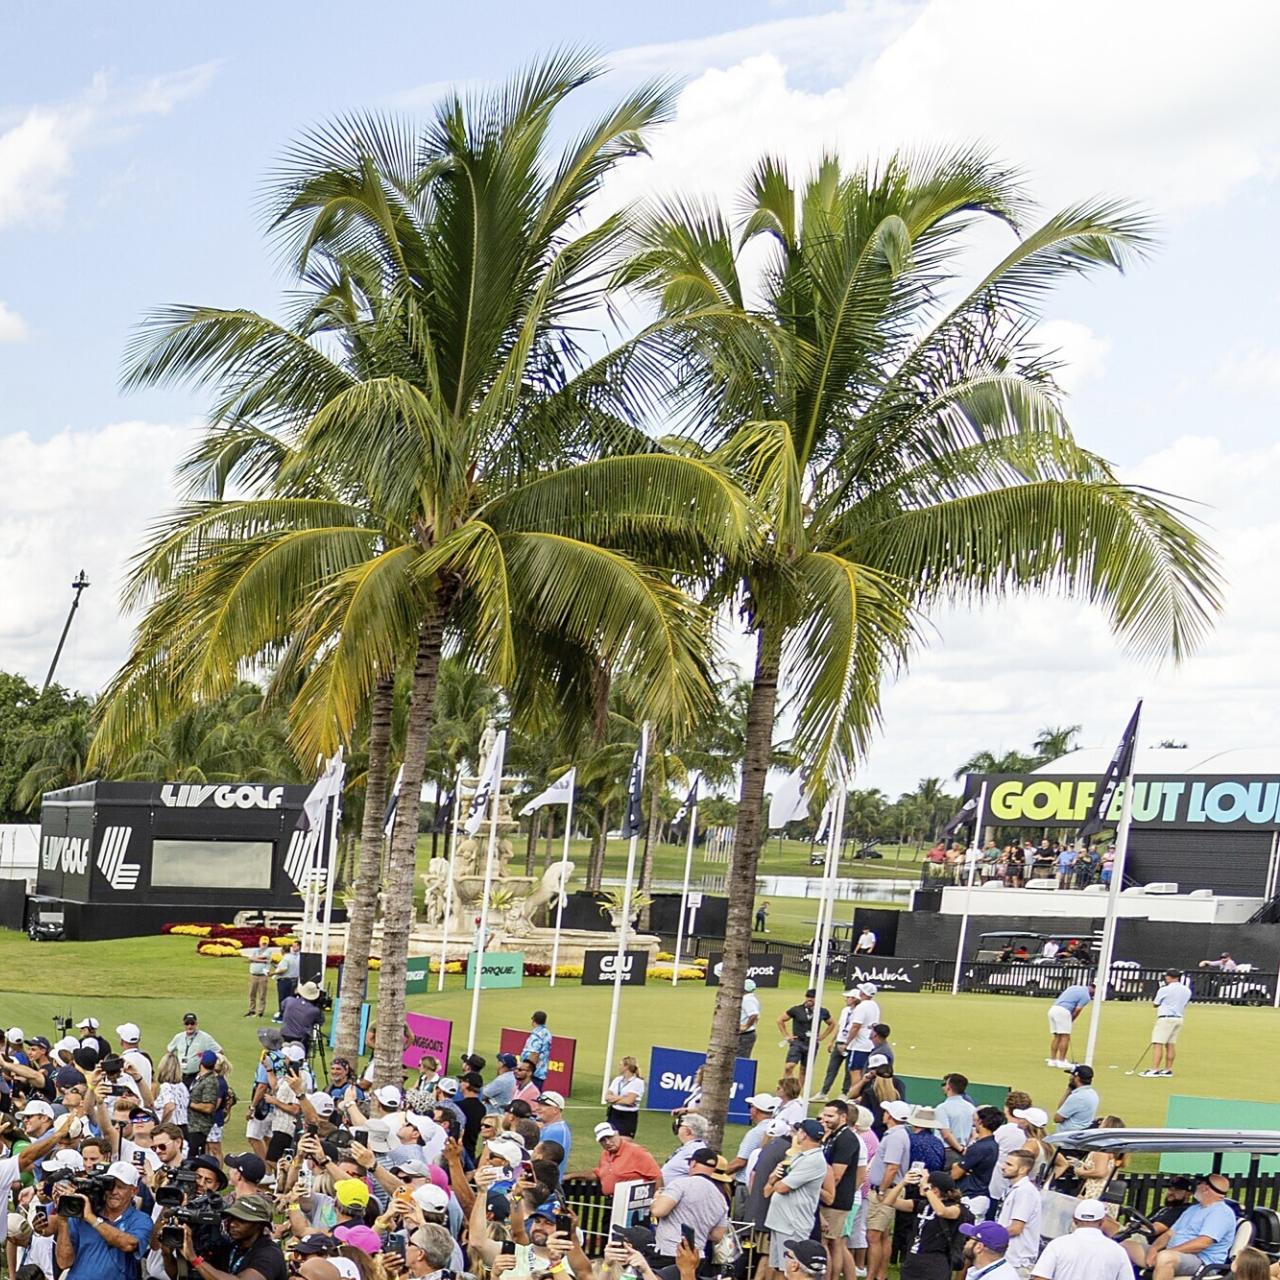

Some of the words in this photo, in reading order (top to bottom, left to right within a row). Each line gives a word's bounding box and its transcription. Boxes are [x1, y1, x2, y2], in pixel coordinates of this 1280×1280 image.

[214, 786, 284, 809] GOLF
[990, 781, 1097, 821] GOLF
[1106, 782, 1186, 822] BUT
[1187, 781, 1280, 823] LOU
[746, 964, 774, 980] ypost
